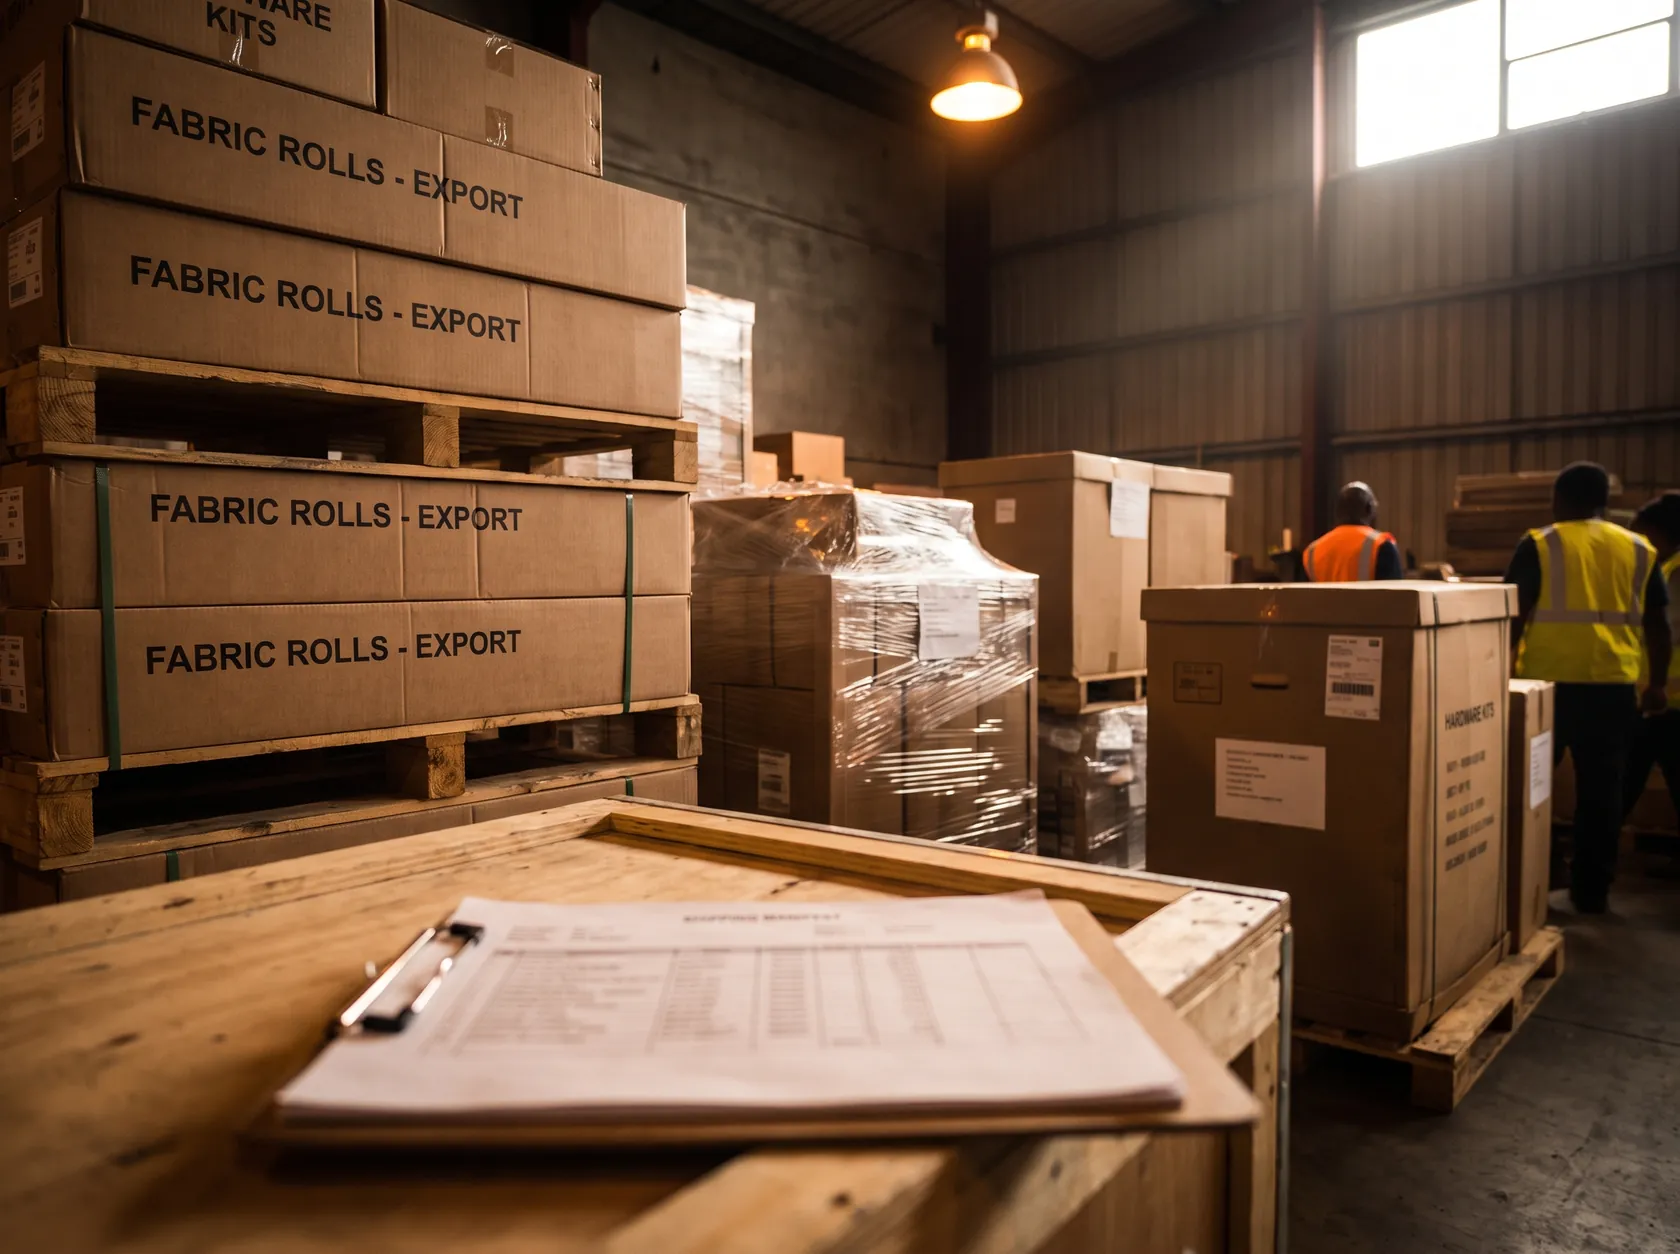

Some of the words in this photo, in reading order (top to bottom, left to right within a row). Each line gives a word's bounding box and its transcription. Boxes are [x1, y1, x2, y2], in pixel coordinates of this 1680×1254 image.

[206, 1, 277, 47] KITS
[131, 95, 267, 156] FABRIC
[278, 133, 385, 186] ROLLS
[395, 177, 405, 185] -
[413, 169, 524, 219] EXPORT
[130, 254, 266, 304] FABRIC
[277, 279, 383, 322] ROLLS
[393, 311, 403, 319] -
[411, 302, 521, 343] EXPORT
[150, 493, 279, 526] FABRIC
[290, 499, 391, 528] ROLLS
[418, 504, 523, 532] EXPORT
[146, 640, 276, 675] FABRIC
[287, 635, 389, 667] ROLLS
[416, 629, 522, 659] EXPORT
[1445, 705, 1481, 731] HARDWARE
